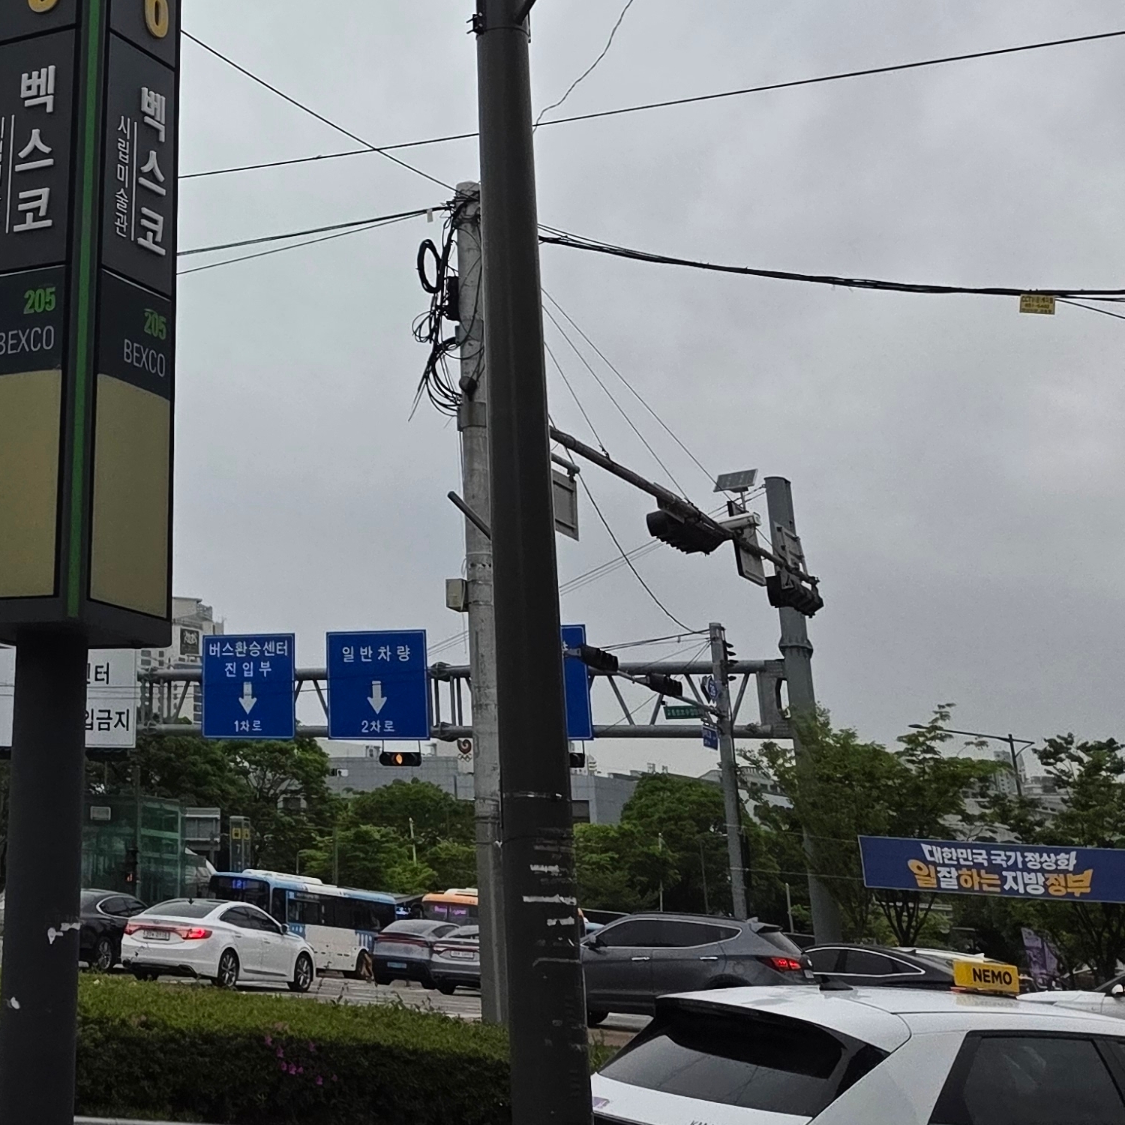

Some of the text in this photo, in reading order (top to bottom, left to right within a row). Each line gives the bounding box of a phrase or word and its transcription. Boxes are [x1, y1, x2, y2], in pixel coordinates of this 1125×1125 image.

[13, 65, 56, 233] 벡스코
[114, 115, 131, 238] 시립미술관
[137, 86, 166, 256] 벡스코
[23, 286, 56, 314] 205
[144, 310, 166, 340] 205
[124, 338, 166, 378] BEXCO
[208, 640, 288, 658] 버스환승센터
[342, 645, 411, 663] 일반차량
[224, 660, 272, 677] 진입부
[234, 720, 262, 732] 1차로
[361, 720, 395, 733] 2차로
[920, 843, 1078, 871] 대한민국 국가 정상화
[908, 858, 1094, 897] 일잘하는 지방정부
[972, 968, 1012, 986] NEMO
